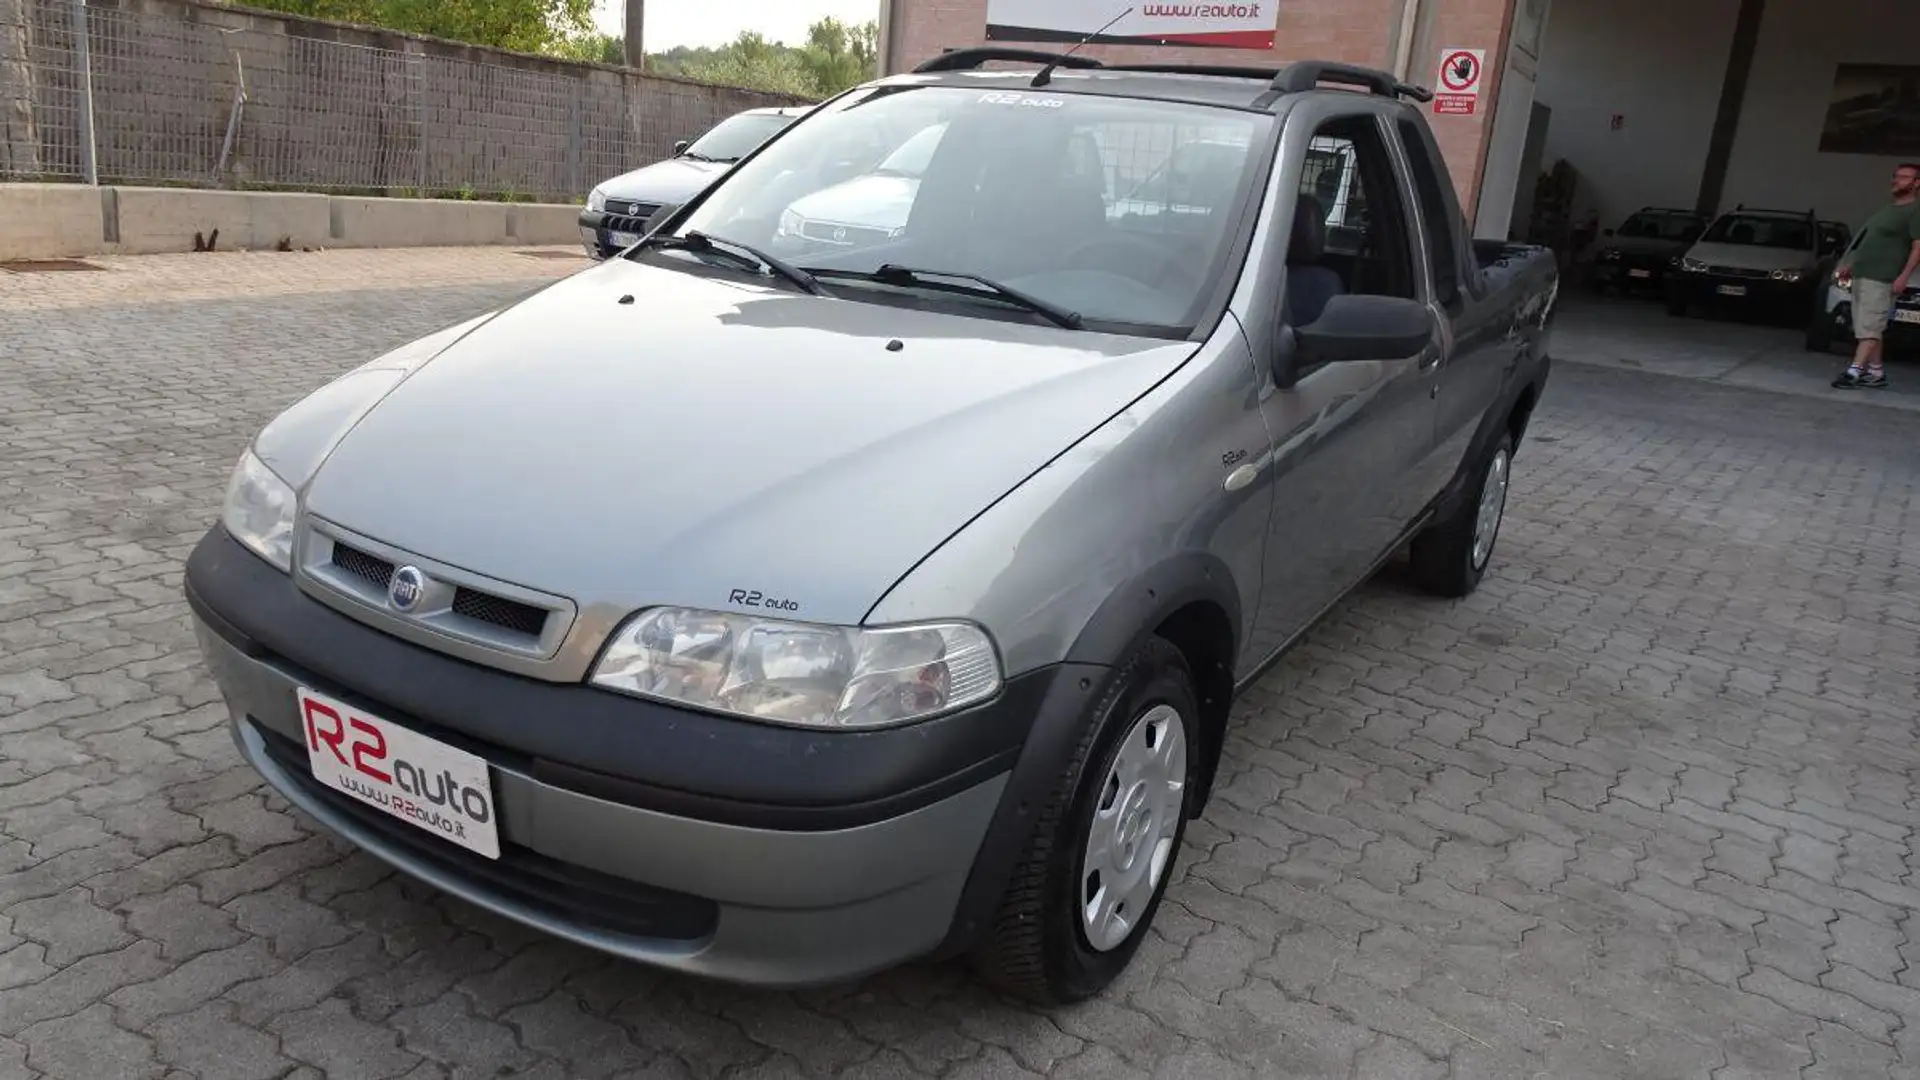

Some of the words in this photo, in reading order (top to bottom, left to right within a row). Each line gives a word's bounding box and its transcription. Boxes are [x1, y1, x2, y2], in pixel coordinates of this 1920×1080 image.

[1143, 4, 1260, 18] www.r2auto.it
[978, 92, 1022, 104] R2
[1022, 98, 1064, 108] auto
[728, 588, 762, 606] R2
[764, 599, 799, 611] auto
[304, 697, 393, 785] R2
[394, 758, 489, 824] auto
